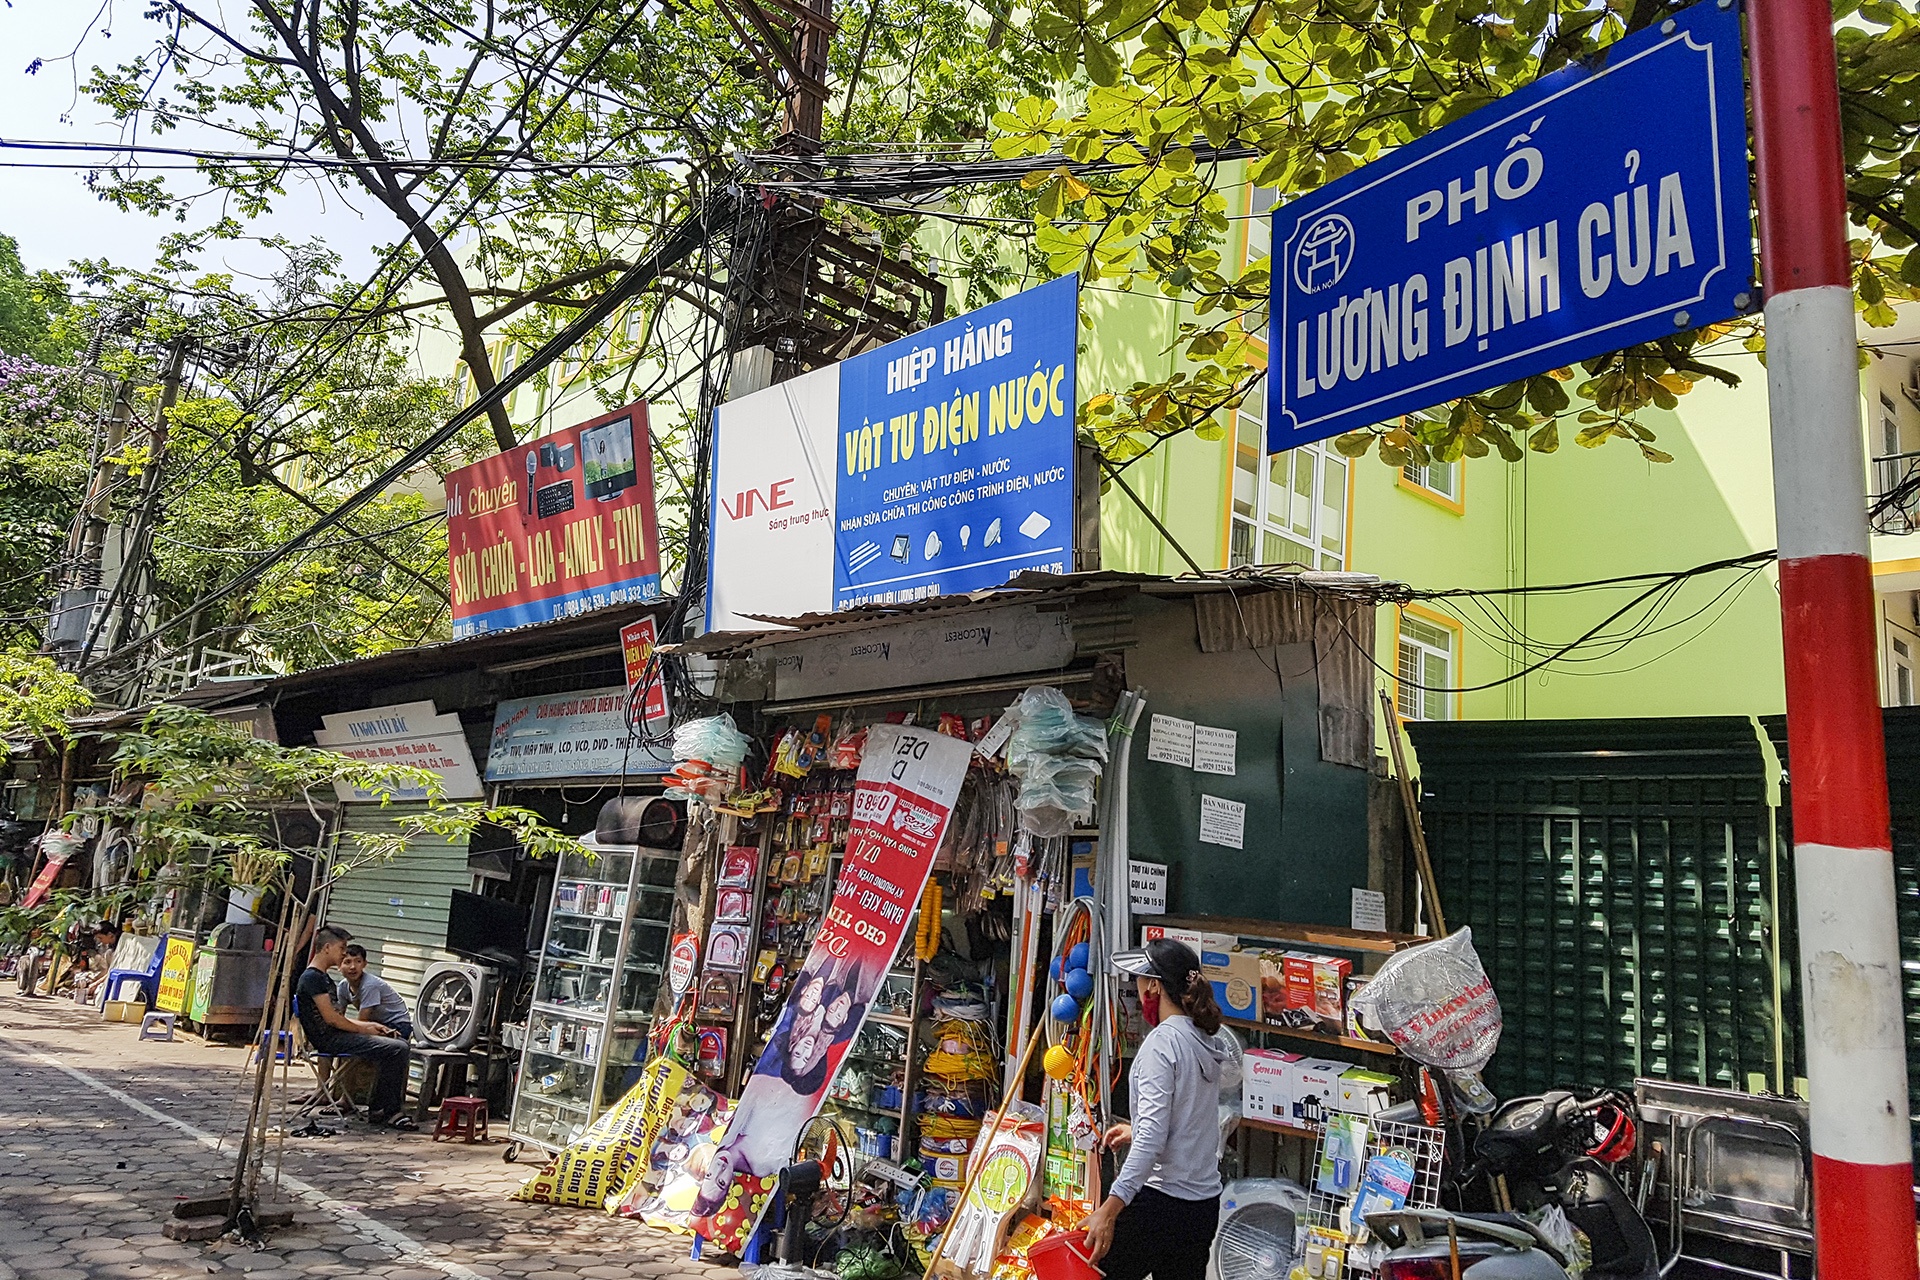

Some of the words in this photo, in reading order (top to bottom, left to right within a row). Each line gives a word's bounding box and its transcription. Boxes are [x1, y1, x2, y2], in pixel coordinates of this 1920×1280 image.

[1405, 116, 1546, 243] PHỐ
[1298, 273, 1428, 399] LƯƠNG
[1443, 219, 1561, 352] ĐỊNH
[1577, 149, 1695, 299] CỦA
[887, 347, 937, 394] HIỆP
[943, 318, 1014, 375] HẰNG
[845, 416, 882, 482] VẬT
[889, 408, 919, 464] TƯ
[922, 387, 980, 457] ĐIỆN
[988, 359, 1065, 435] NƯỚC
[468, 475, 518, 515] Chuyên
[883, 482, 919, 503] CHUYÊN:
[921, 477, 938, 494] VẬT
[939, 474, 953, 487] TƯ
[953, 468, 975, 486] ĐIỆN
[981, 458, 1011, 478] NƯỚC
[906, 502, 920, 515] THI
[922, 495, 947, 513] CÔNG
[948, 489, 975, 506] CÔNG
[976, 482, 1005, 500] TRÌNH
[1033, 467, 1065, 487] NƯỚC
[769, 518, 787, 530] Sáng
[790, 514, 810, 525] trung
[812, 507, 829, 521] thực
[481, 529, 518, 599] CHỮA
[527, 529, 557, 589] LOA
[628, 586, 642, 601] 332
[642, 581, 656, 597] 492
[850, 642, 890, 661] ALCOREST
[944, 626, 992, 648] ALCOREST
[592, 739, 608, 751] DVD
[897, 842, 918, 859] CUNG
[1151, 898, 1158, 906] 15
[854, 921, 887, 946] CHO
[567, 1159, 586, 1194] Giáng
[585, 1158, 605, 1198] Quang
